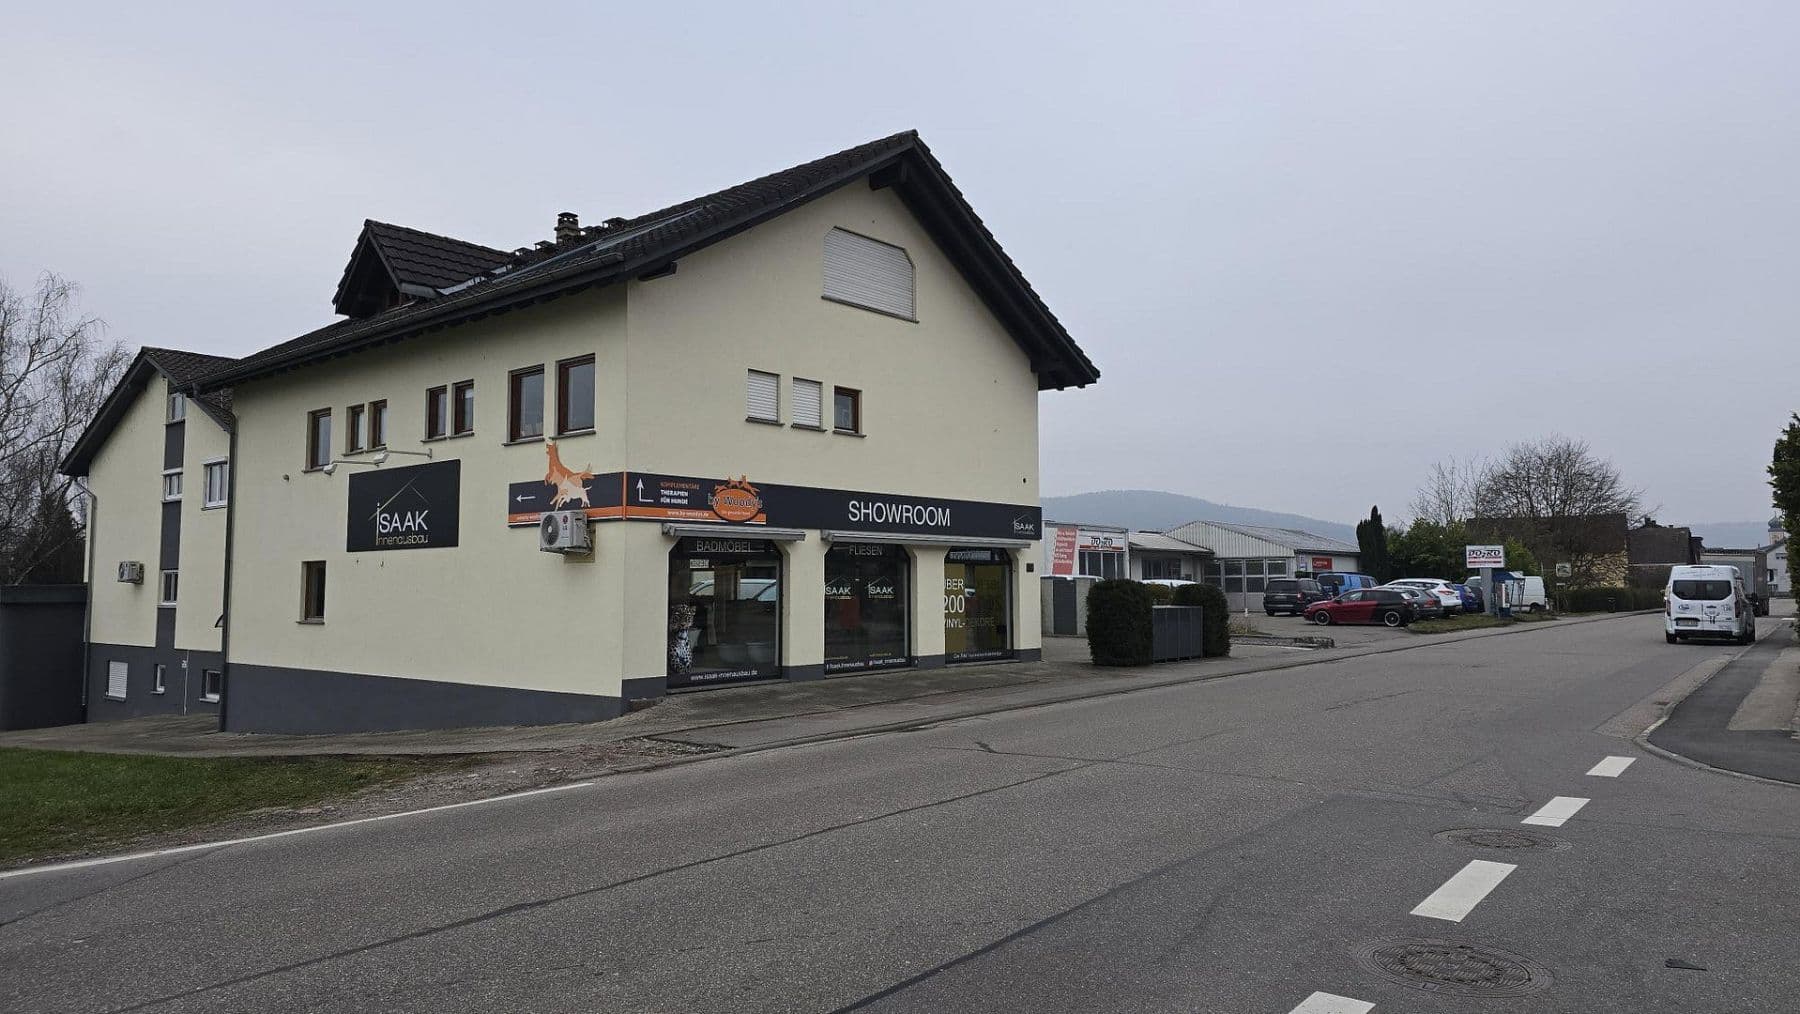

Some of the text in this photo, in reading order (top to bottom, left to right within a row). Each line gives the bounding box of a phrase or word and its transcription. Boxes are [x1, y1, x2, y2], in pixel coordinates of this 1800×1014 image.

[660, 489, 689, 497] THERAPIEN
[848, 500, 951, 527] SHOWROOM
[849, 544, 883, 555] FLIESEN
[944, 579, 964, 590] BER
[944, 595, 965, 613] 200
